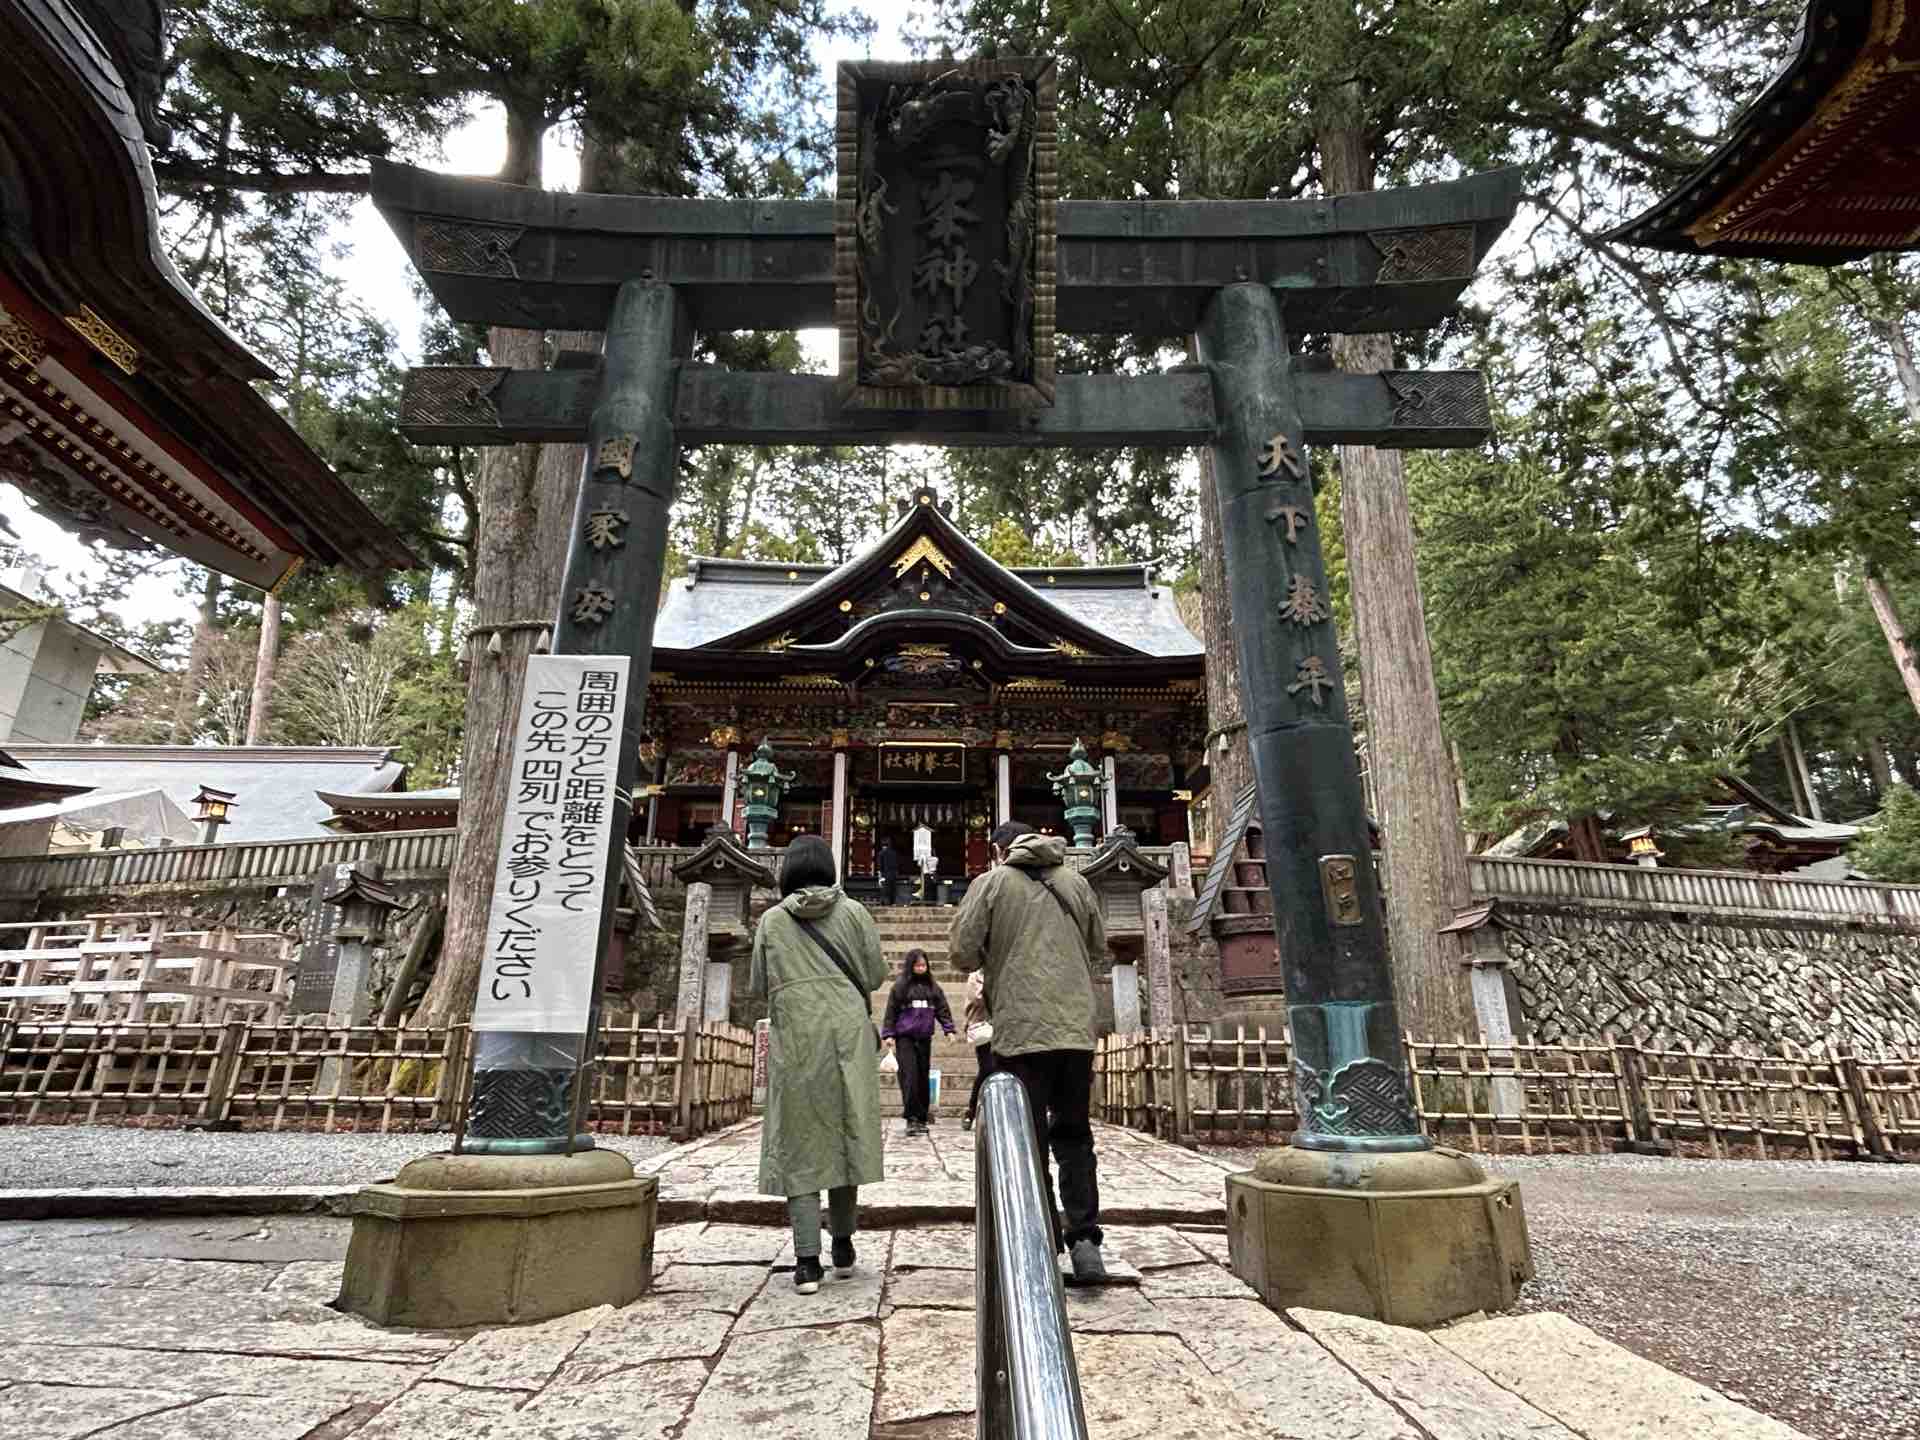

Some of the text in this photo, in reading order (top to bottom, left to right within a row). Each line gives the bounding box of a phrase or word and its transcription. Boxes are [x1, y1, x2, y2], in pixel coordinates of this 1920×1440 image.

[1257, 432, 1335, 706] 天下泰平
[491, 691, 568, 1000] この先四列でお参りください
[554, 671, 618, 911] 周囲の方と距離をとって
